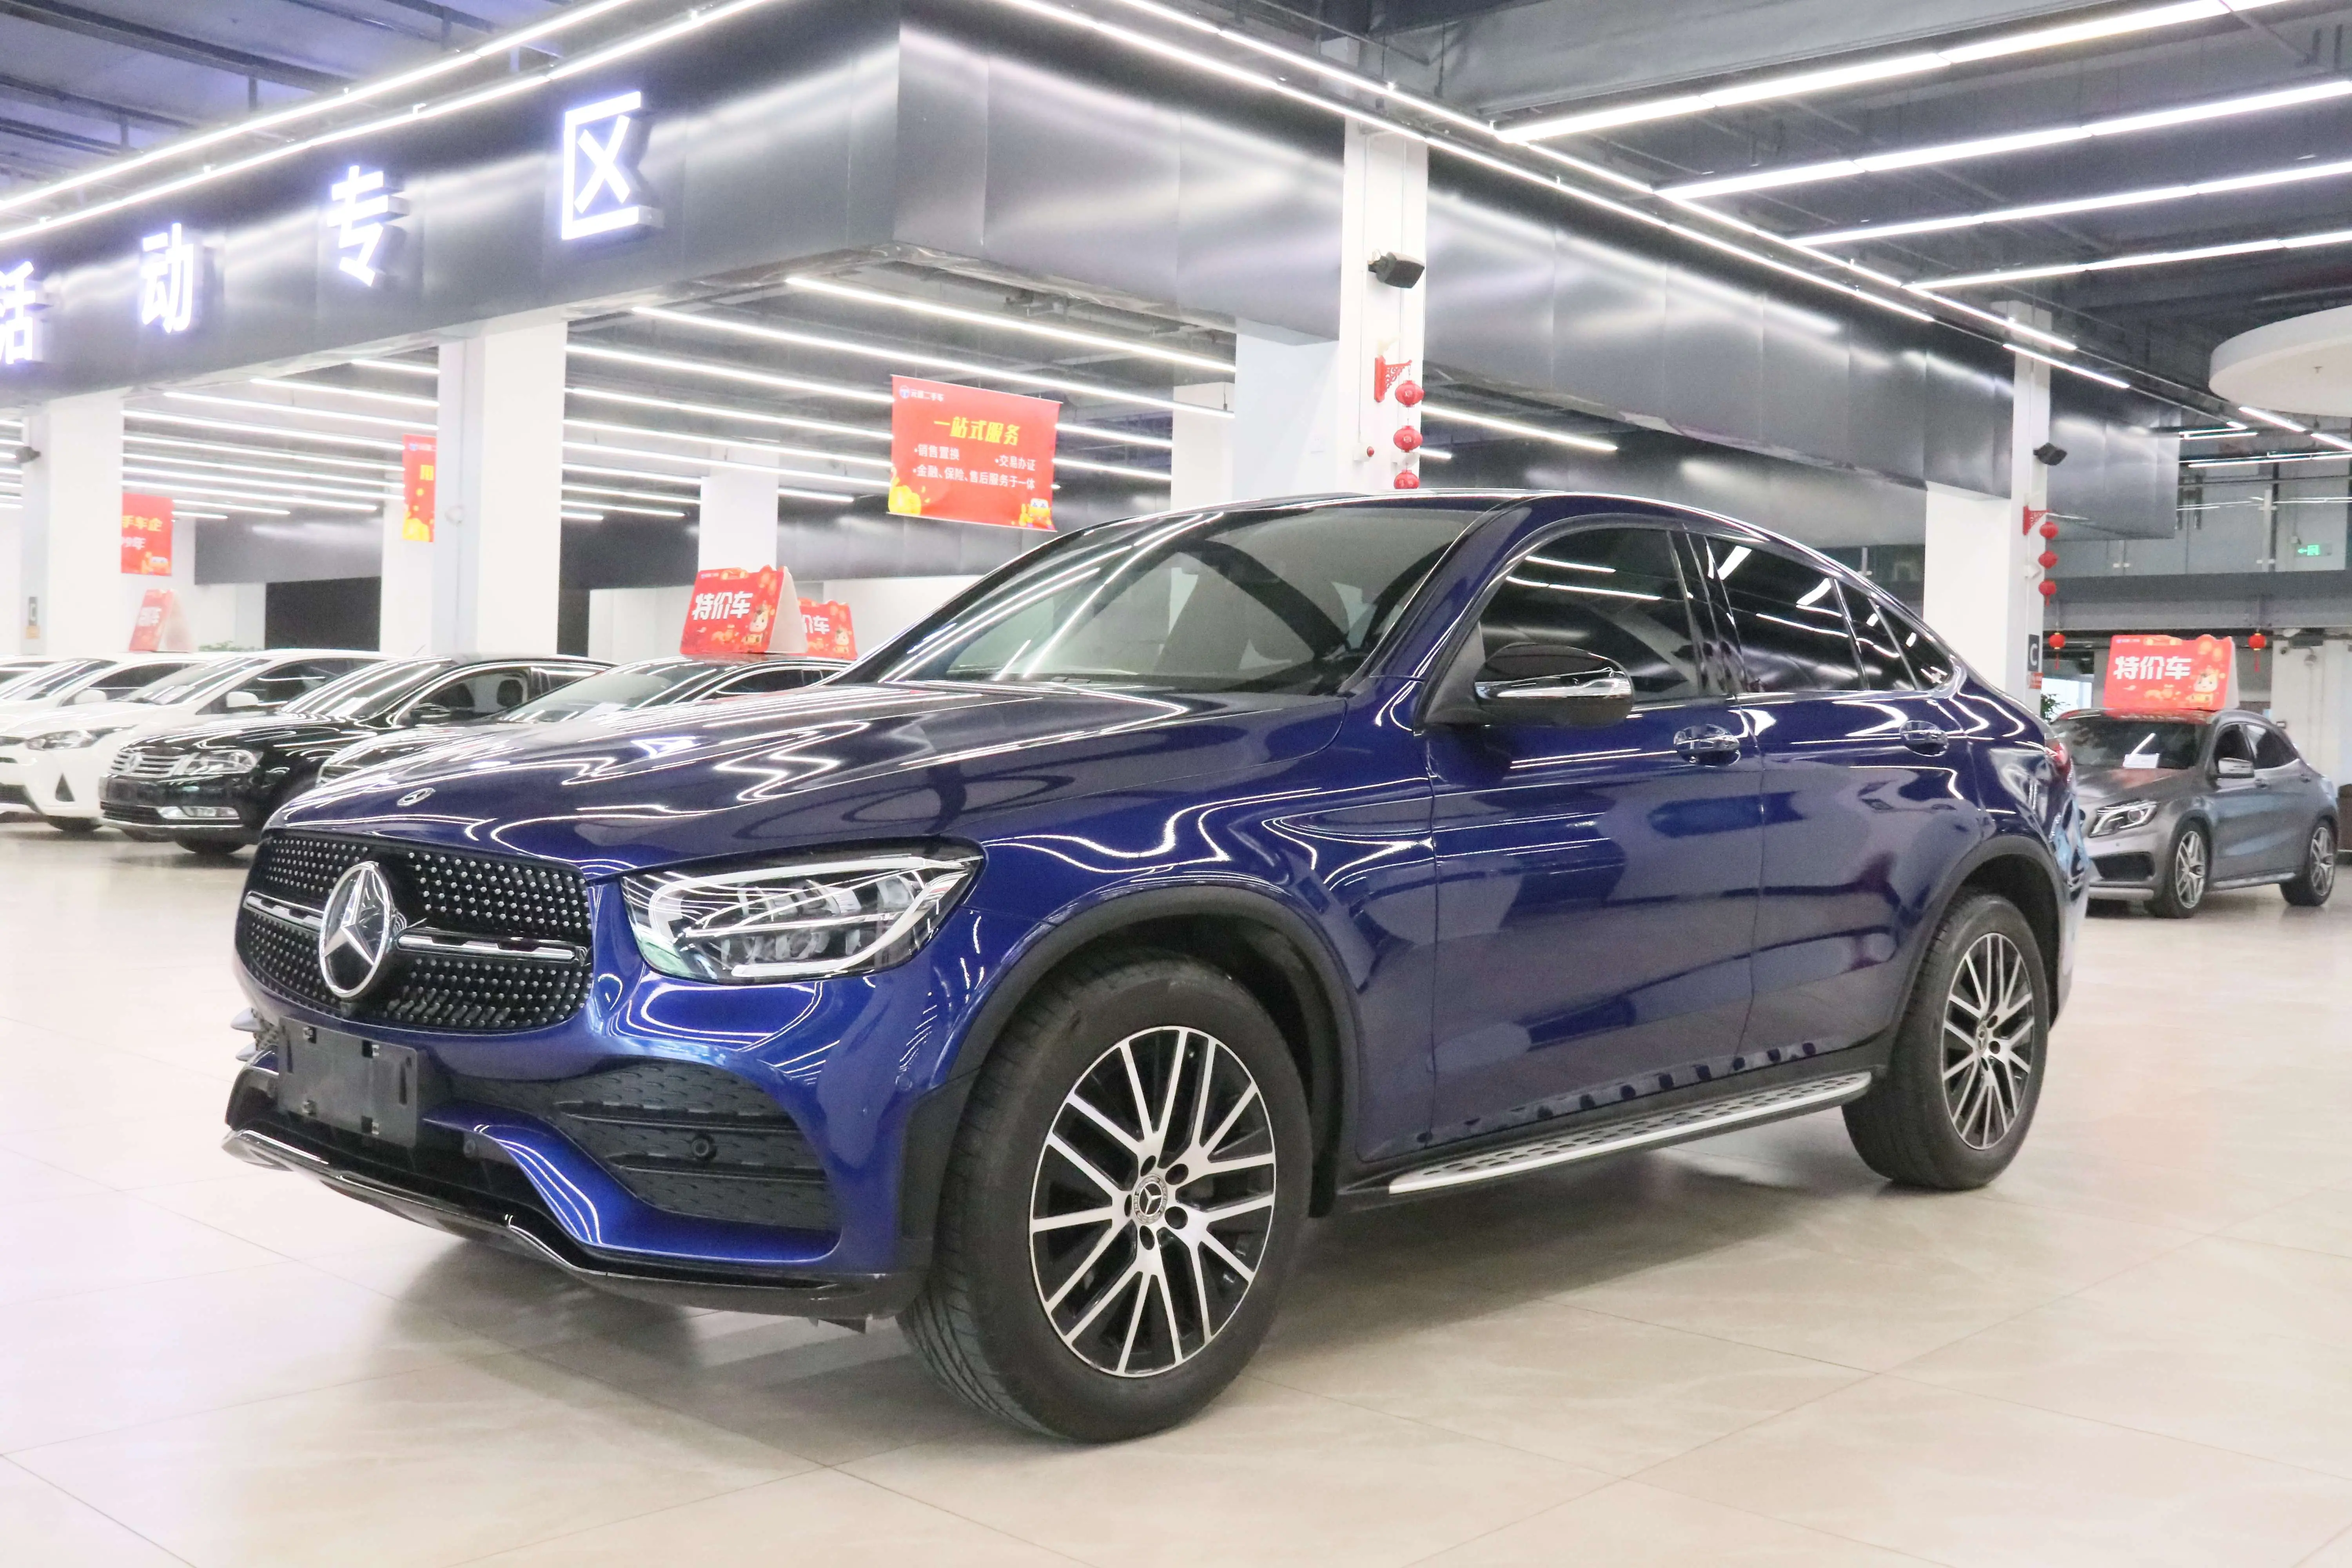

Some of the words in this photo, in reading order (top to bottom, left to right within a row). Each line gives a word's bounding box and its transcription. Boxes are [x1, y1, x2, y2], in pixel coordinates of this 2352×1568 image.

[0, 91, 641, 365] 活动专区
[934, 416, 1020, 446] 一站式服务
[918, 443, 960, 461] 销售置换
[998, 455, 1037, 471] 交易办证
[916, 464, 1036, 490] 金融、保险、售后服务于一体
[691, 591, 753, 620] 特价车
[2030, 643, 2038, 666] C
[2113, 656, 2192, 680] 特价车
